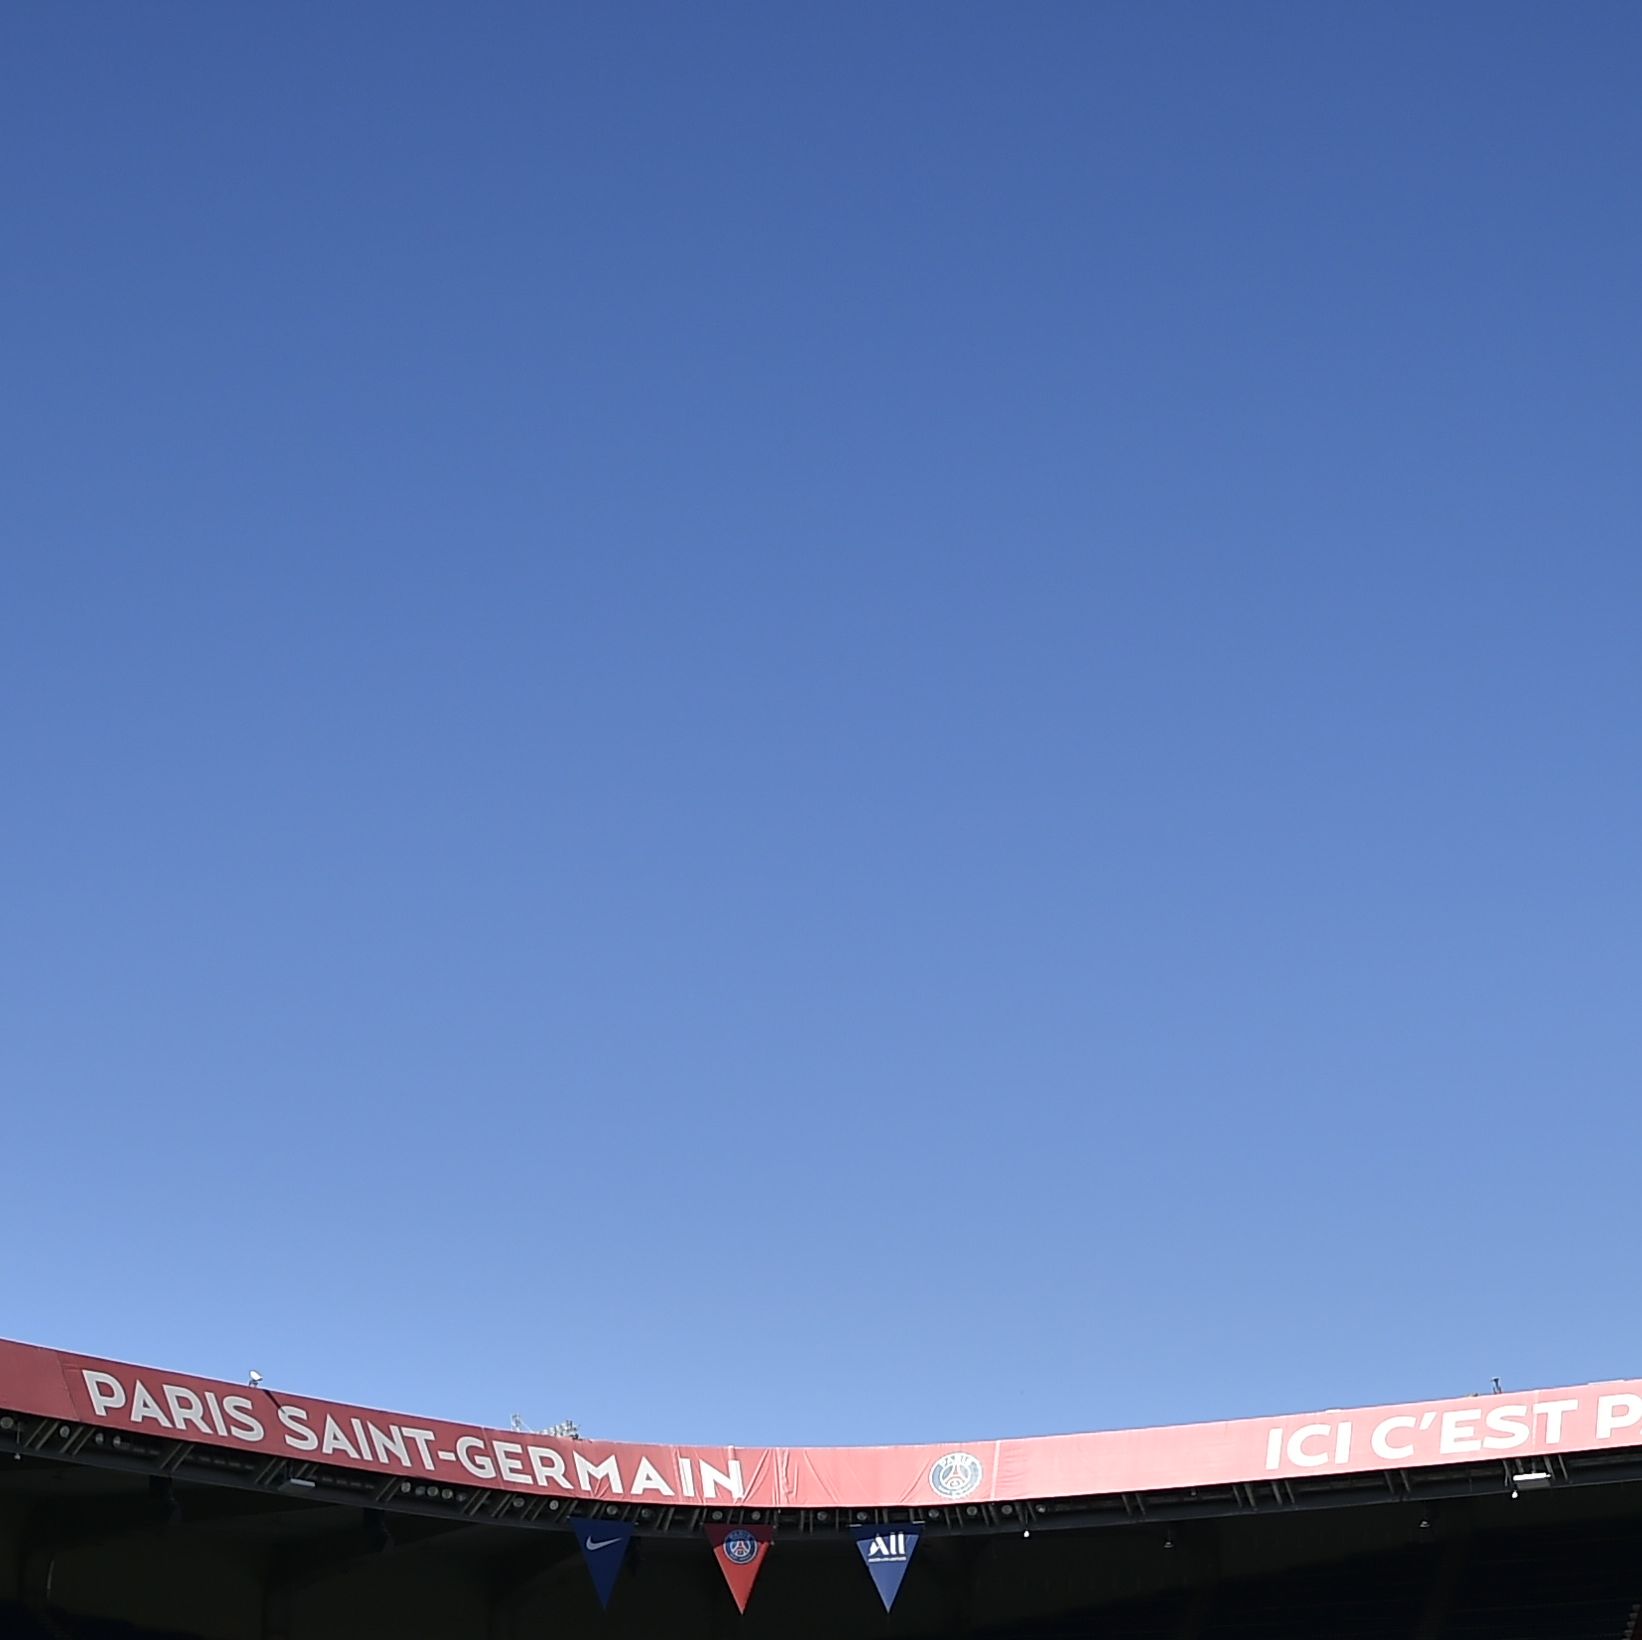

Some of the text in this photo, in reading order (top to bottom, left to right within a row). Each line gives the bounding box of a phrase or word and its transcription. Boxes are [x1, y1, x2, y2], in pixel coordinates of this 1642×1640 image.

[80, 1369, 745, 1502] PARIS SAINT-GERMAIN
[1264, 1422, 1352, 1470] ICI
[1371, 1399, 1578, 1460] C'EST
